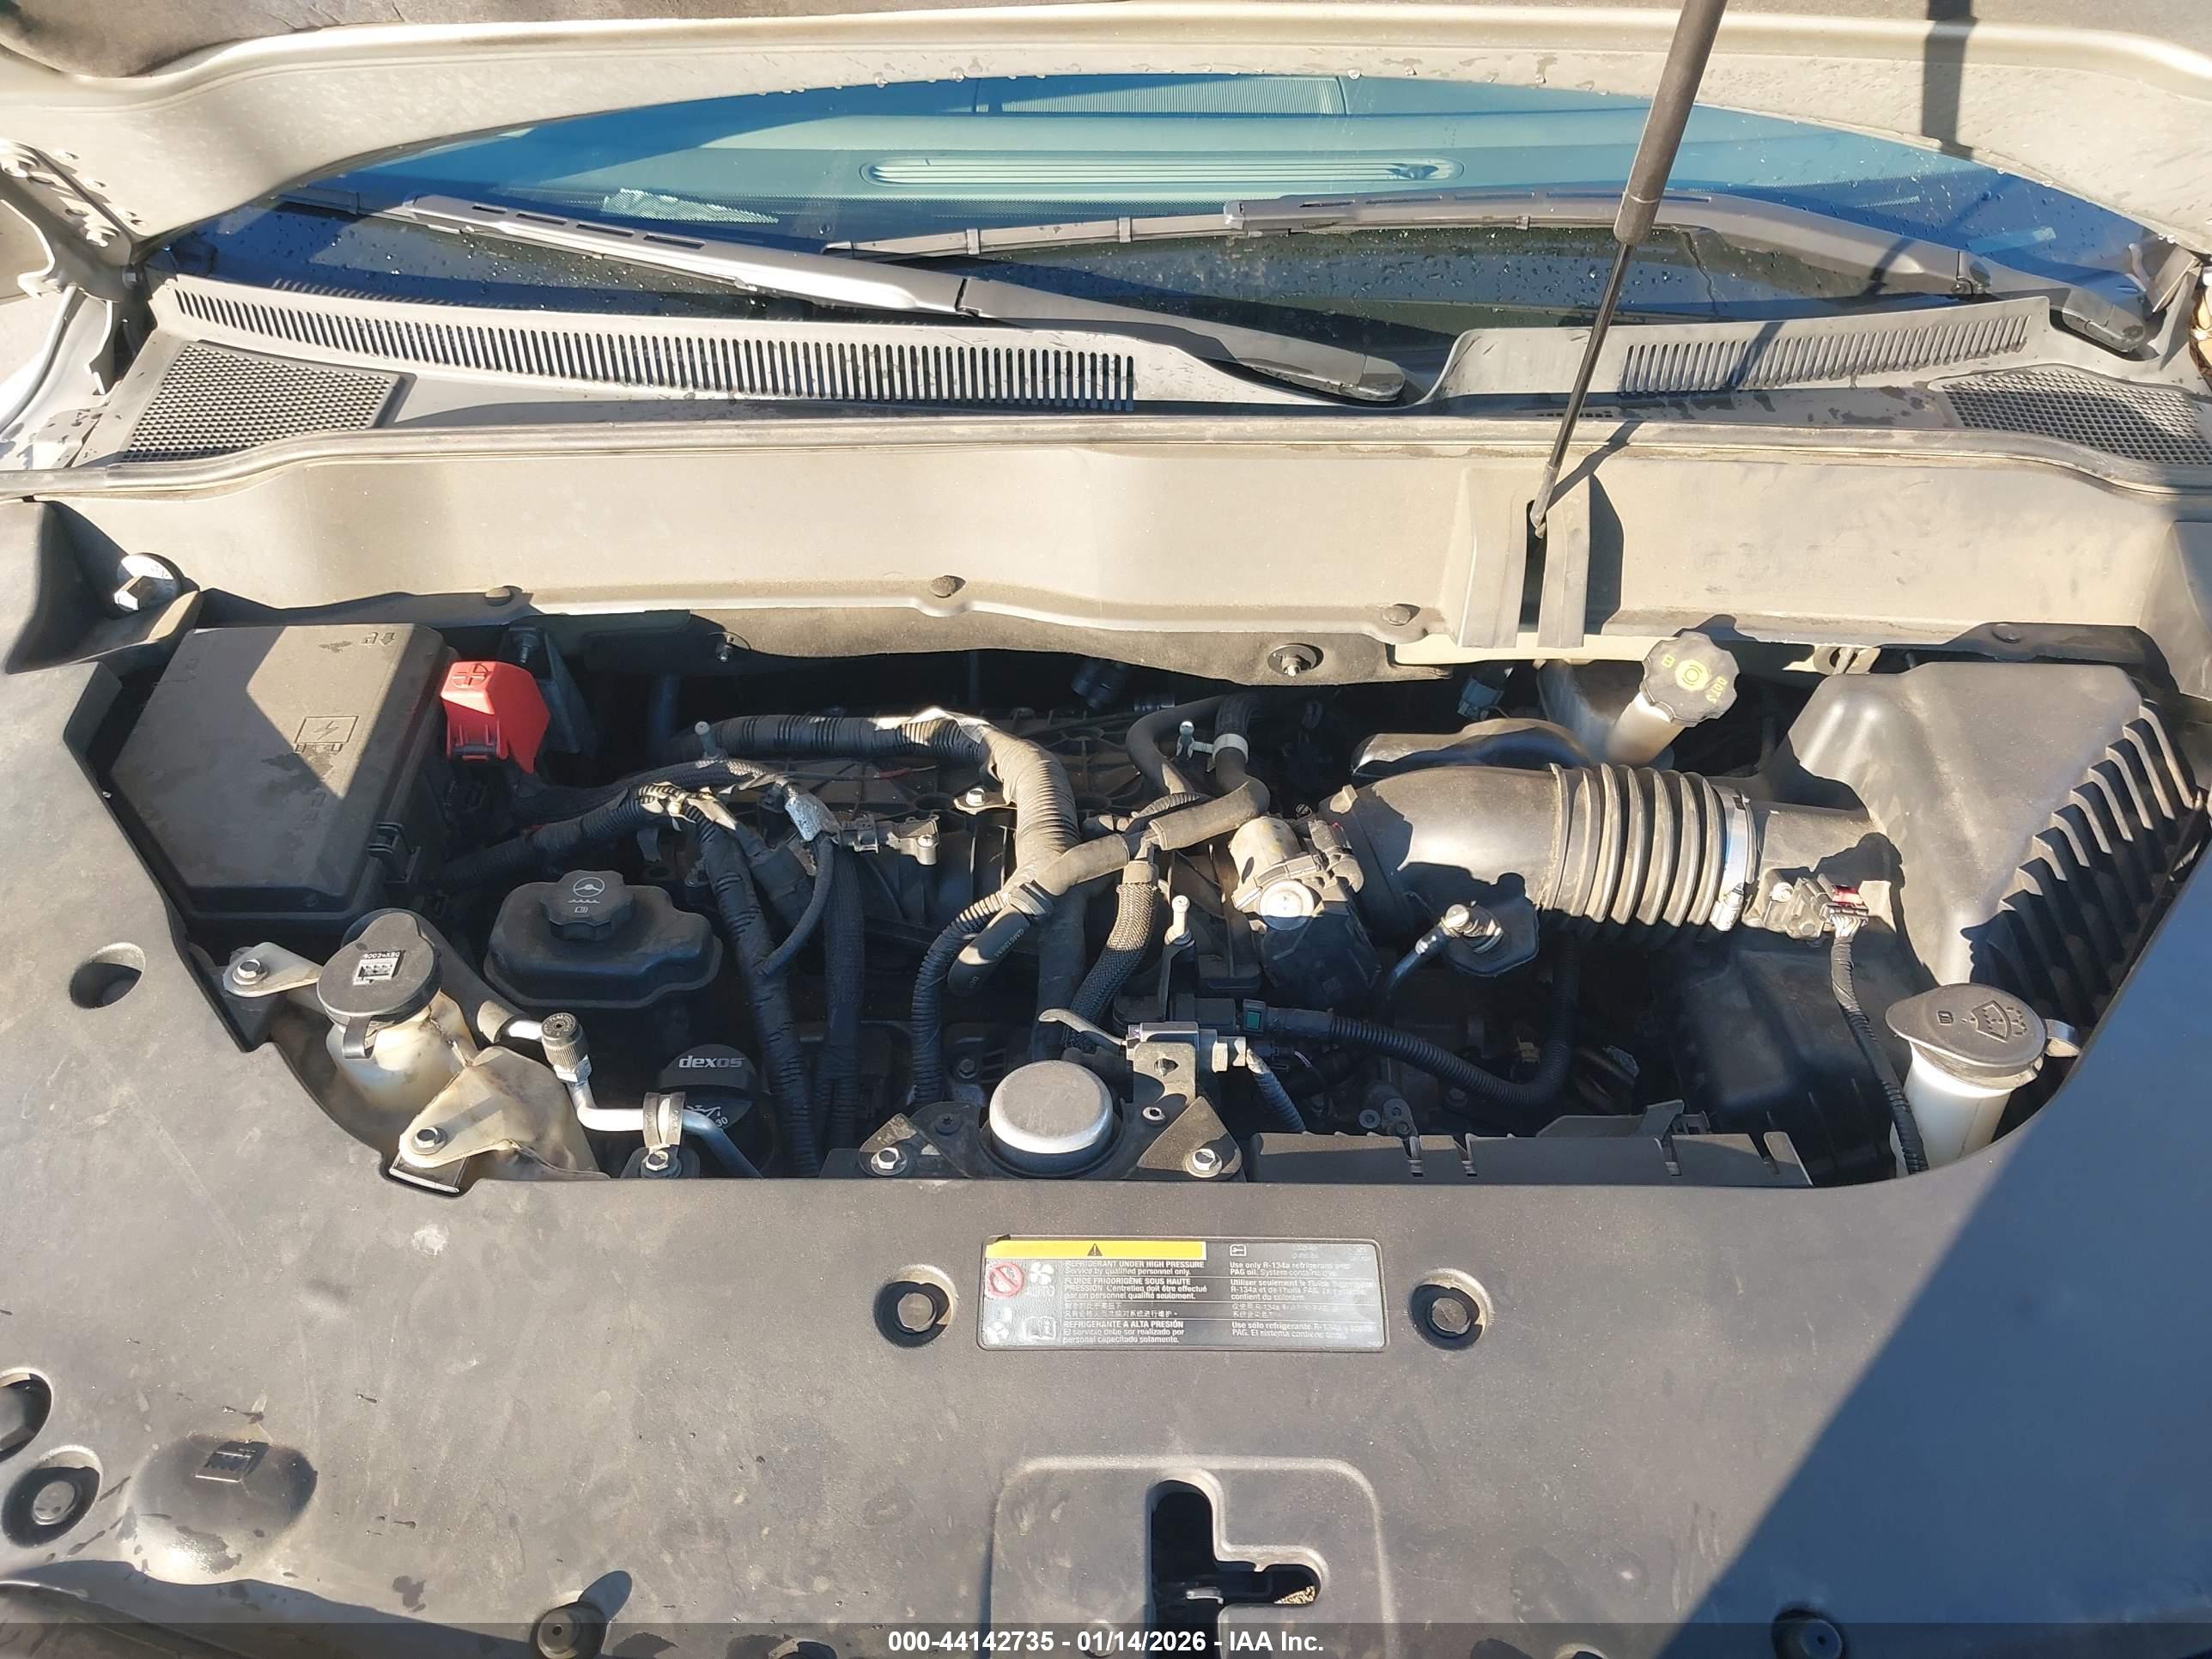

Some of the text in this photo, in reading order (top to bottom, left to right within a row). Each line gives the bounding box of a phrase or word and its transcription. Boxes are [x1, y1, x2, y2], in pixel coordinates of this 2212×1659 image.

[678, 1055, 744, 1068] dexos
[1245, 1261, 1261, 1270] only
[1174, 1268, 1191, 1277] only.
[1093, 1277, 1144, 1285] FRIGORIGÈNE
[1151, 1319, 1184, 1328] PRESIÓN
[1265, 1322, 1311, 1331] refrigerante
[1064, 1336, 1096, 1345] personal
[1097, 1336, 1138, 1345] capacitado
